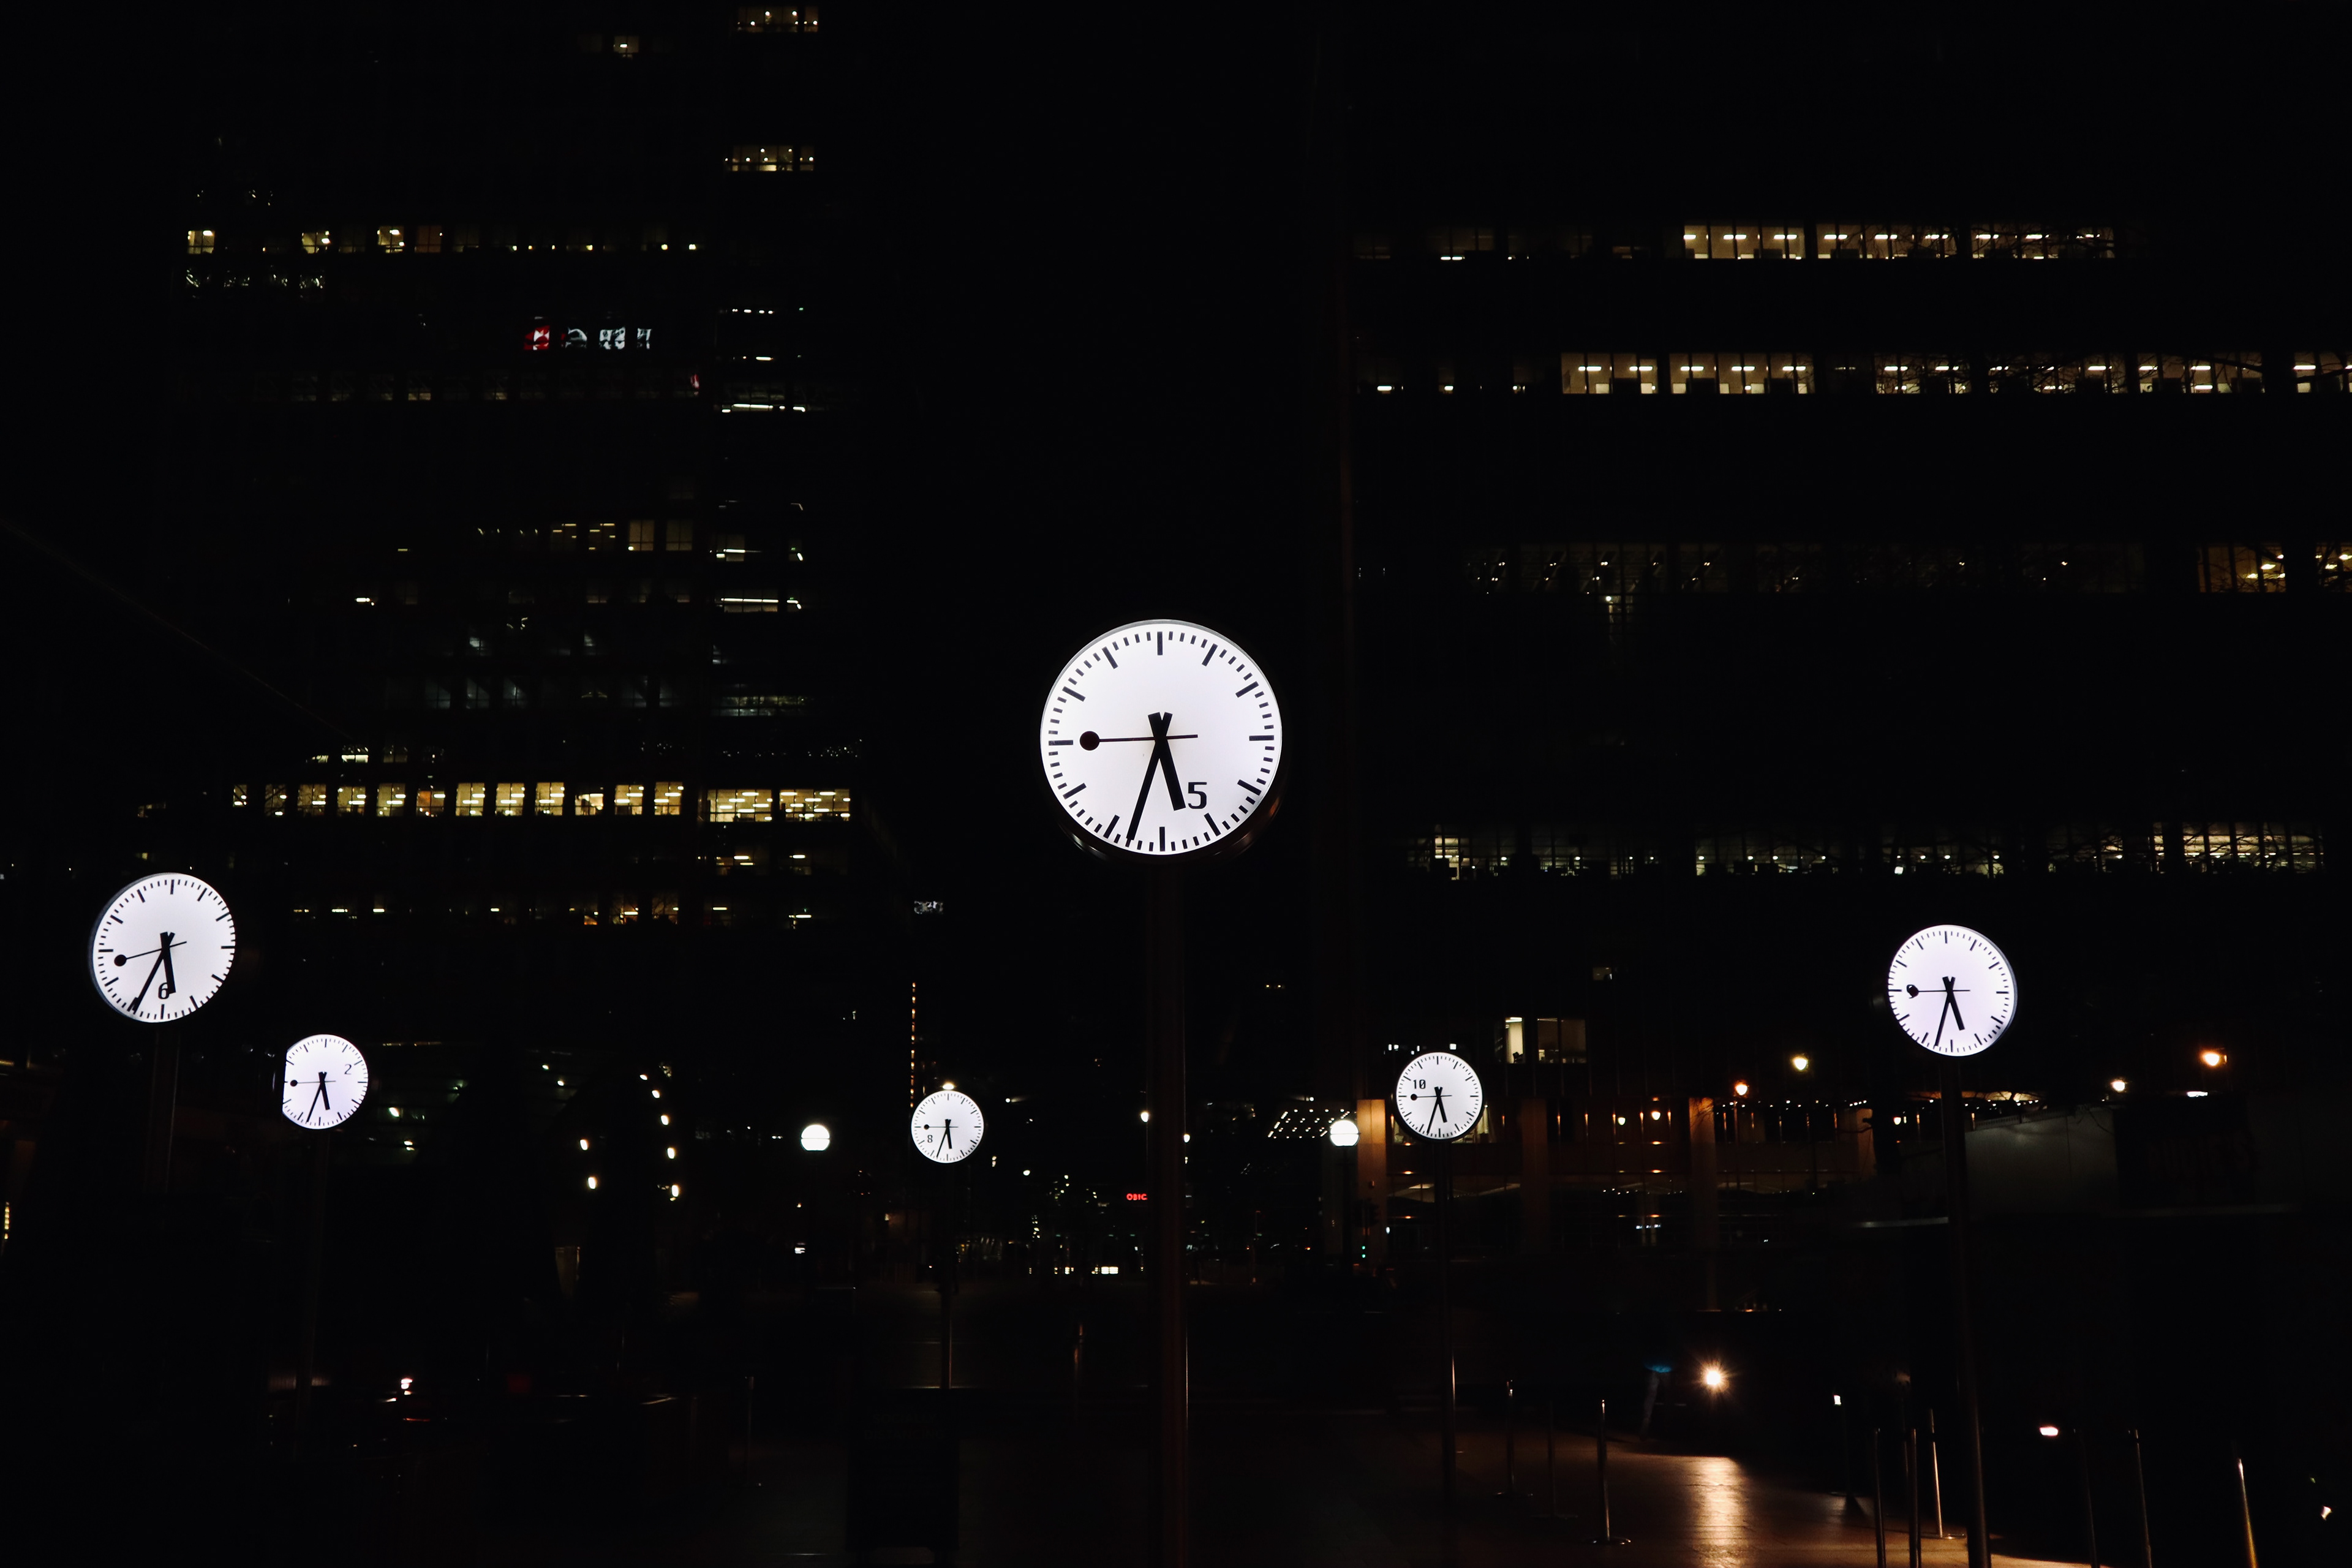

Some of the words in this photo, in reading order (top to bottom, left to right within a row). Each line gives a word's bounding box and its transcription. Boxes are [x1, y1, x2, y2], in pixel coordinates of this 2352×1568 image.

[1188, 782, 1207, 810] 5
[158, 982, 170, 1000] 6
[344, 1063, 352, 1075] 2
[1413, 1079, 1426, 1090] 10
[927, 1134, 933, 1144] 8
